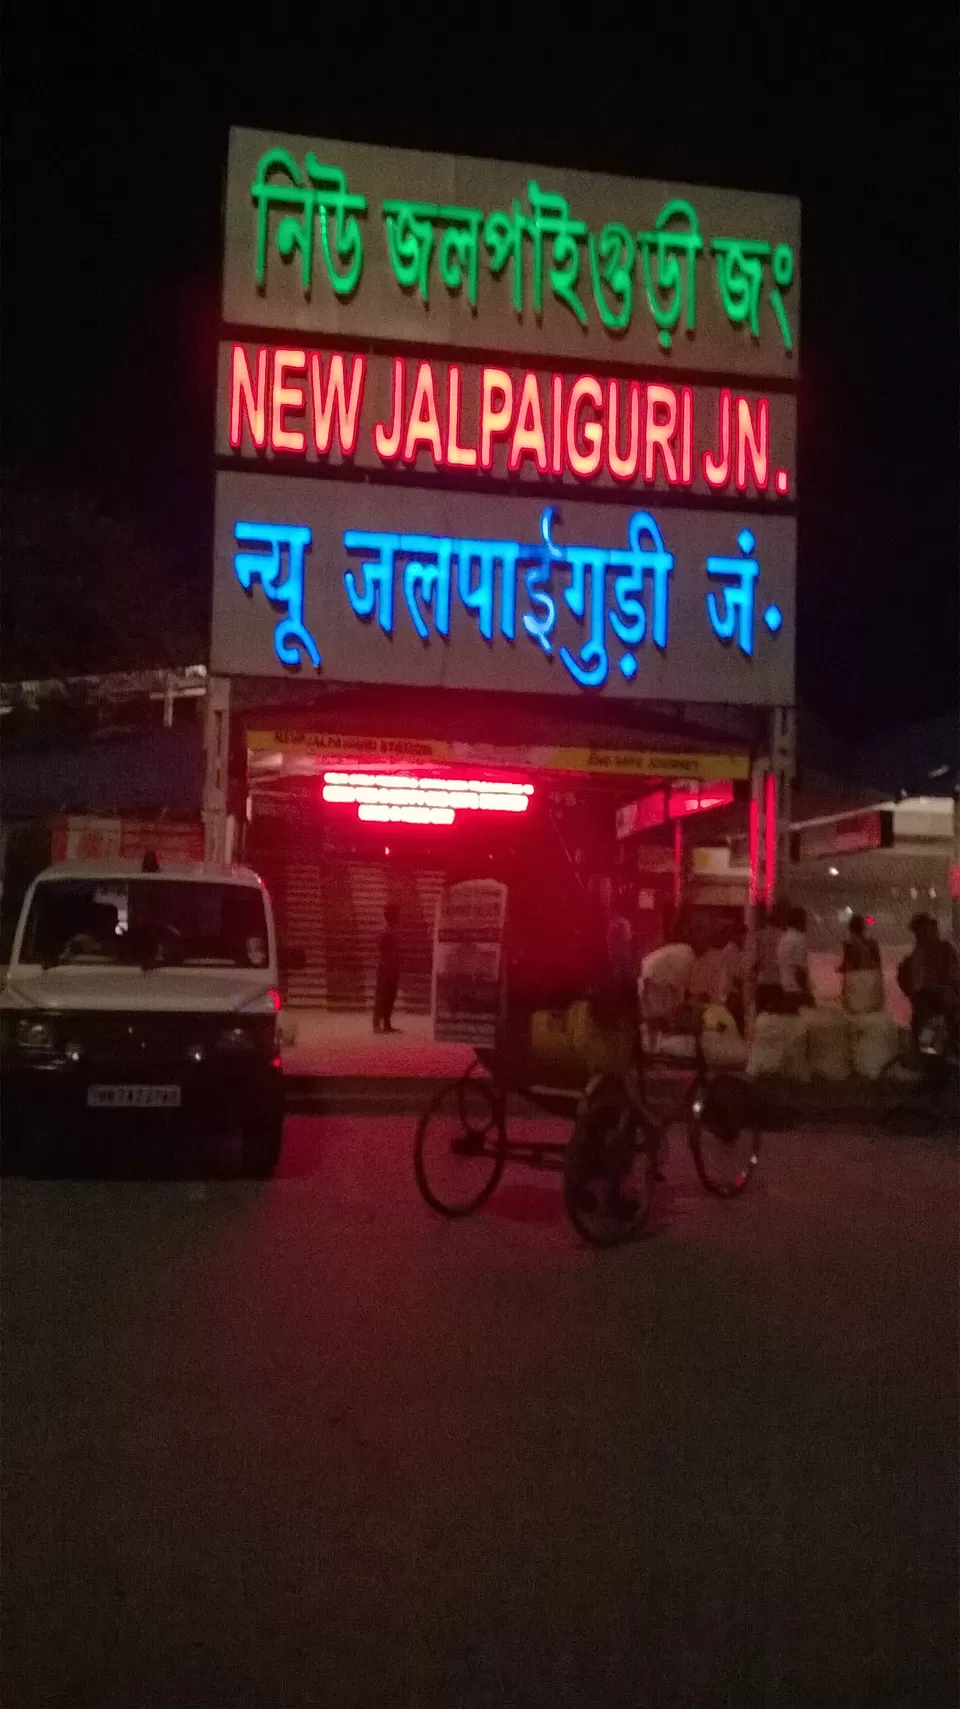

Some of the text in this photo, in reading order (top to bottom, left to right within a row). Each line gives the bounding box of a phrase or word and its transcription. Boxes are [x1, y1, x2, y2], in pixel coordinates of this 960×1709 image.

[250, 146, 368, 297] নিউ
[710, 236, 794, 350] জং
[229, 343, 790, 495] NEW JALPAIGURI JN.
[232, 520, 322, 668] न्यू
[342, 505, 676, 688] जलपाईगुड़ी
